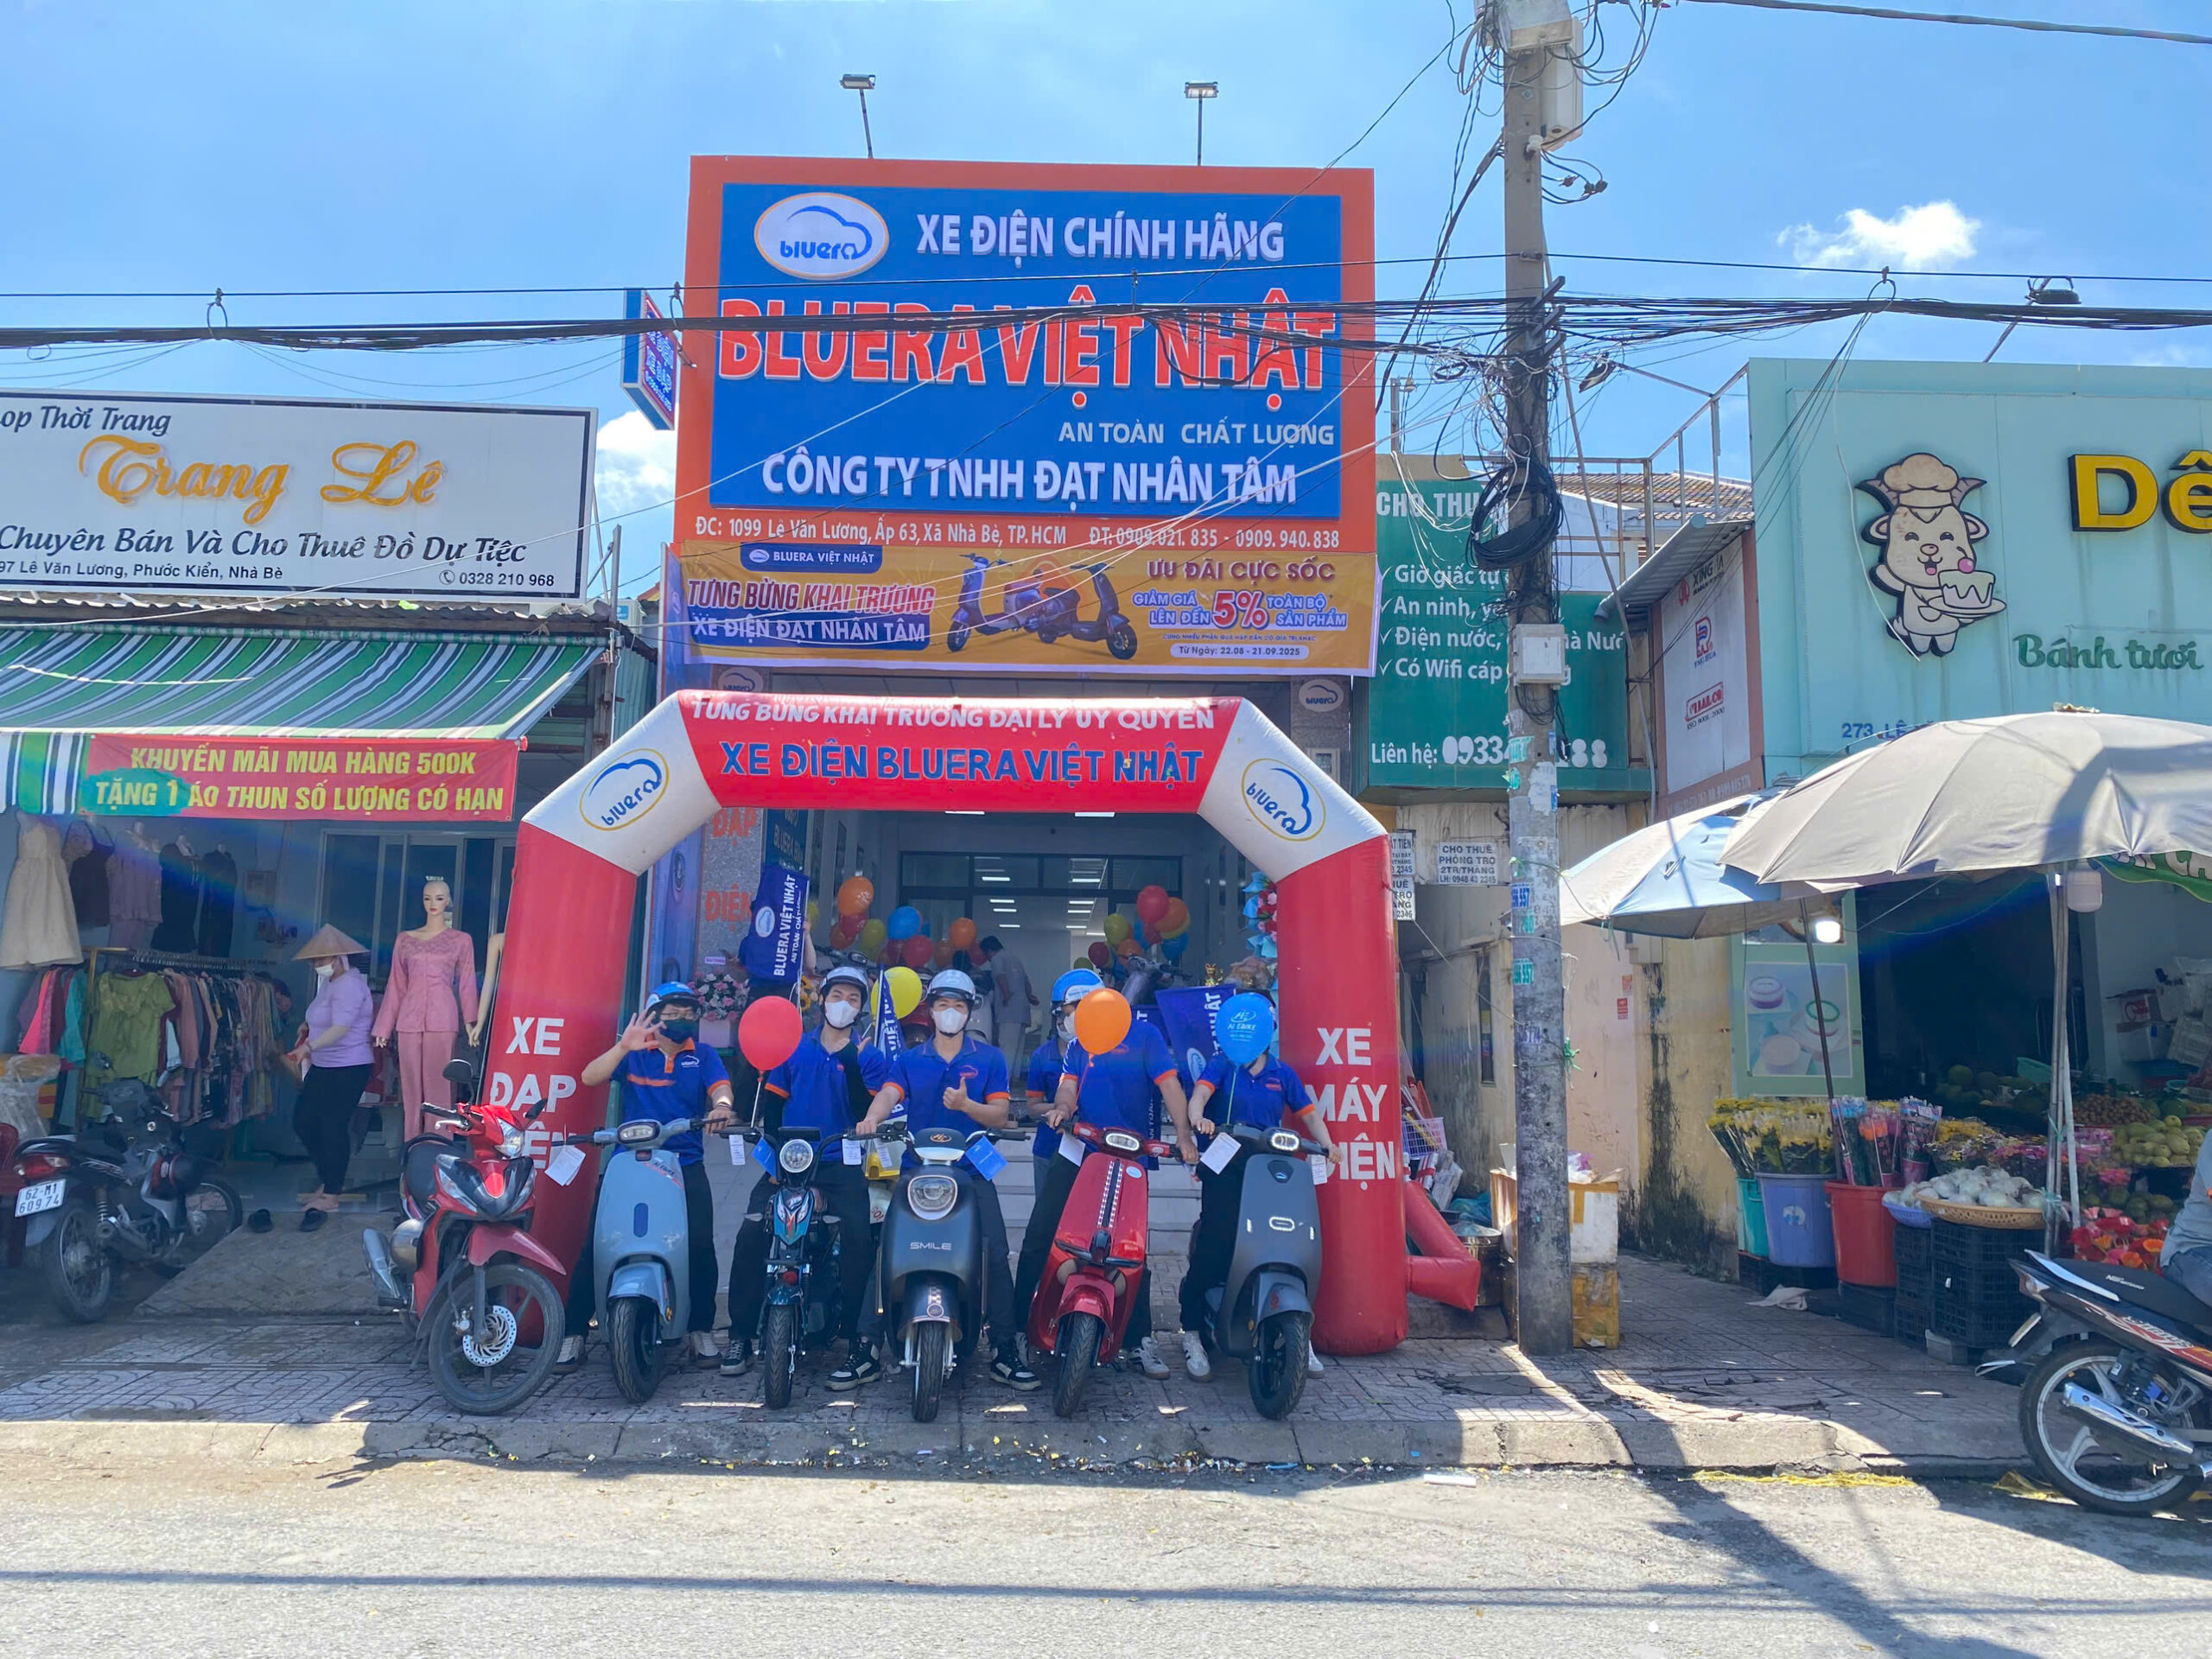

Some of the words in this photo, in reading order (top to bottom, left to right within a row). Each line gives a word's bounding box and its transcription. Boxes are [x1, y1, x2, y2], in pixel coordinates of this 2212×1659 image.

[916, 213, 962, 255] XE
[970, 207, 1054, 269] ĐIỆN
[1064, 210, 1176, 260] CHÍNH
[1185, 212, 1285, 262] HÃNG
[719, 297, 987, 386] BLUERA
[995, 284, 1144, 410] VIỆT
[1154, 288, 1337, 412] NHẬT
[41, 405, 93, 431] Thời
[101, 406, 172, 437] Trang
[1058, 422, 1094, 443] AN
[1099, 418, 1165, 444] TOÀN
[1181, 416, 1247, 444] CHẤT
[1253, 423, 1335, 448] LƯỢNG
[79, 434, 290, 525] Trang
[320, 440, 446, 507] Lê
[762, 446, 868, 495] CÔNG
[874, 456, 921, 498] TY
[925, 457, 1024, 499] TNHH
[1034, 461, 1106, 512] ĐẠT
[1112, 455, 1212, 504] NHÂN
[1221, 455, 1296, 505] TÂM
[1376, 491, 1427, 517] CHO
[696, 516, 722, 536] ĐC:
[729, 518, 762, 537] 1099
[768, 519, 785, 537] Lê
[790, 520, 817, 539] Văn
[823, 521, 874, 544] Lương,
[875, 513, 895, 544] Ấp
[924, 524, 942, 542] Xã
[948, 523, 976, 543] Nhà
[982, 524, 1003, 547] Bè,
[1009, 524, 1066, 544] TP.HCM
[0, 524, 105, 556] Chuyên
[114, 527, 175, 554] Bán
[186, 529, 224, 554] Và
[231, 530, 289, 556] Cho
[299, 531, 367, 559] Thuê
[373, 531, 416, 560] Đồ
[422, 536, 468, 567] Dự
[475, 537, 528, 568] Tiệc
[773, 551, 815, 563] BLUERA
[817, 550, 841, 565] VIỆT
[842, 550, 874, 566] NHẬT
[20, 559, 38, 575] Lê
[44, 561, 70, 575] Văn
[76, 562, 129, 579] Lương,
[133, 561, 180, 578] Phước
[229, 563, 259, 579] Nhà
[264, 563, 283, 579] Bè
[459, 572, 494, 586] 0328
[498, 572, 524, 587] 210
[529, 573, 556, 588] 968
[1183, 557, 1223, 581] ĐÃI
[1230, 560, 1281, 587] CỰC
[1286, 556, 1337, 582] SỐC
[1395, 563, 1432, 584] Giờ
[1433, 563, 1475, 589] giấc
[1479, 569, 1501, 591] tự
[803, 584, 852, 613] KHAI
[1133, 588, 1170, 607] GIẢM
[1171, 589, 1198, 607] GIÁ
[1211, 589, 1269, 631] 5%
[1266, 594, 1305, 609] TOÀN
[1306, 594, 1327, 613] BỘ
[1393, 595, 1421, 615] An
[694, 616, 717, 637] XE
[723, 613, 771, 643] ĐIỆN
[778, 621, 815, 644] ĐẠT
[822, 620, 872, 641] NHÂN
[884, 617, 926, 643] TÂM
[1149, 608, 1176, 625] LÊN
[1180, 607, 1211, 626] ĐẾN
[1276, 611, 1306, 626] SẢN
[1307, 609, 1347, 627] PHẨM
[1179, 645, 1191, 655] Từ
[1192, 646, 1218, 657] Ngày:
[1220, 646, 1245, 655] 22.08
[1252, 647, 1300, 656] 21.09.2025
[1395, 626, 1435, 652] Điện
[1447, 628, 1502, 650] nước,
[2013, 633, 2123, 670] Bánh
[2124, 636, 2205, 671] tươi
[1395, 657, 1421, 677] Có
[1426, 658, 1463, 678] Wifi
[1468, 661, 1503, 686] cáp
[823, 706, 877, 725] KHAI
[1841, 722, 1874, 739] 273
[130, 741, 226, 773] KHUYẾN
[232, 746, 280, 773] MÃI
[285, 750, 338, 775] MUA
[345, 747, 411, 775] HÀNG
[416, 752, 478, 776] 500K
[719, 741, 770, 775] XE
[781, 737, 868, 785] ĐIỆN
[876, 745, 1020, 782] BLUERA
[1023, 741, 1105, 788] VIỆT
[1114, 741, 1205, 790] NHẬT
[1371, 742, 1408, 764] Liên
[1412, 741, 1439, 769] hệ:
[96, 778, 159, 811] TẶNG
[188, 780, 220, 808] ÁO
[227, 785, 289, 810] THUN
[295, 779, 329, 811] SỐ
[333, 785, 410, 817] LƯỢNG
[417, 783, 449, 811] CÓ
[454, 787, 505, 817] HẠN
[1442, 845, 1464, 854] CHO
[783, 874, 800, 906] NHẬT
[779, 906, 794, 934] VIỆT
[772, 931, 791, 977] BLUERA
[505, 1016, 564, 1056] XE
[1315, 1027, 1372, 1066] XE
[490, 1071, 577, 1119] ĐẠP
[1305, 1076, 1389, 1122] MÁY
[910, 1242, 952, 1250] SMILE
